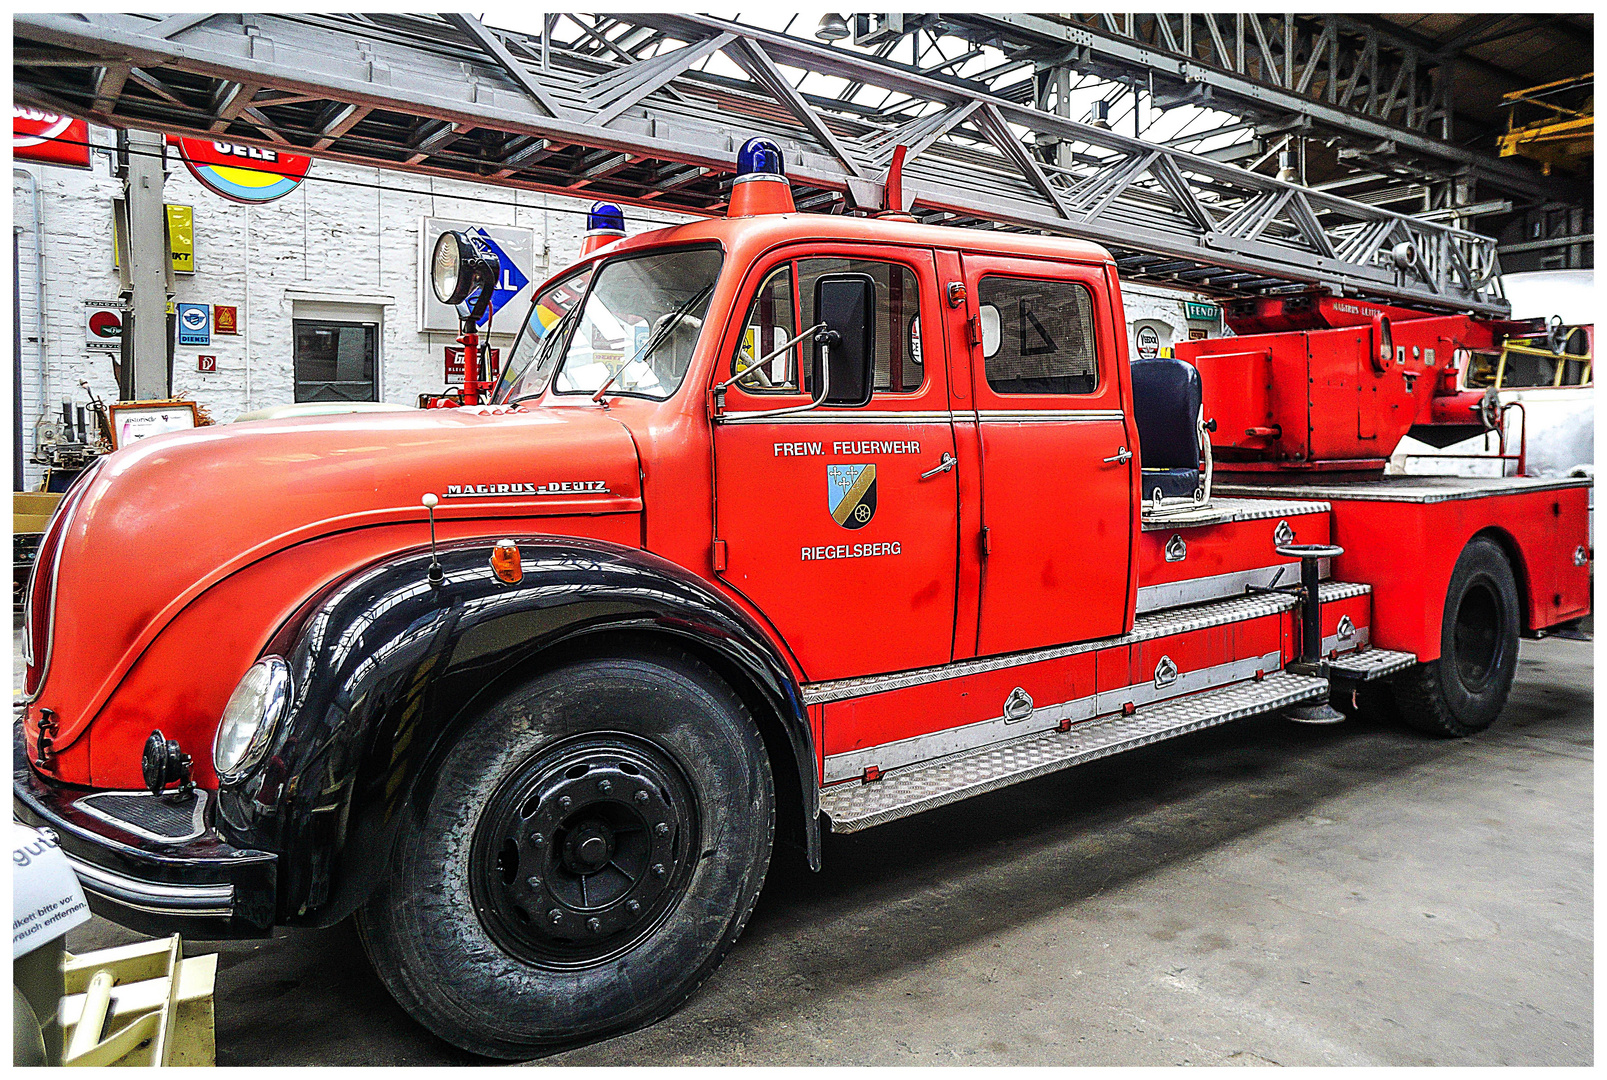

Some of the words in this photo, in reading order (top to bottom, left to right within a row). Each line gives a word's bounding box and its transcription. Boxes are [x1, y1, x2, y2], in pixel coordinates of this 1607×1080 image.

[1190, 305, 1217, 317] FENDT
[1140, 334, 1158, 346] VEEDOL
[773, 442, 826, 457] FREIW.
[832, 440, 922, 455] FEUERWEHR
[447, 480, 606, 494] MAGIRUS-DEUTZ
[800, 541, 902, 561] RIEGELSBERG
[37, 902, 59, 917] bitte
[59, 895, 74, 905] vor
[44, 902, 87, 926] entfernen.
